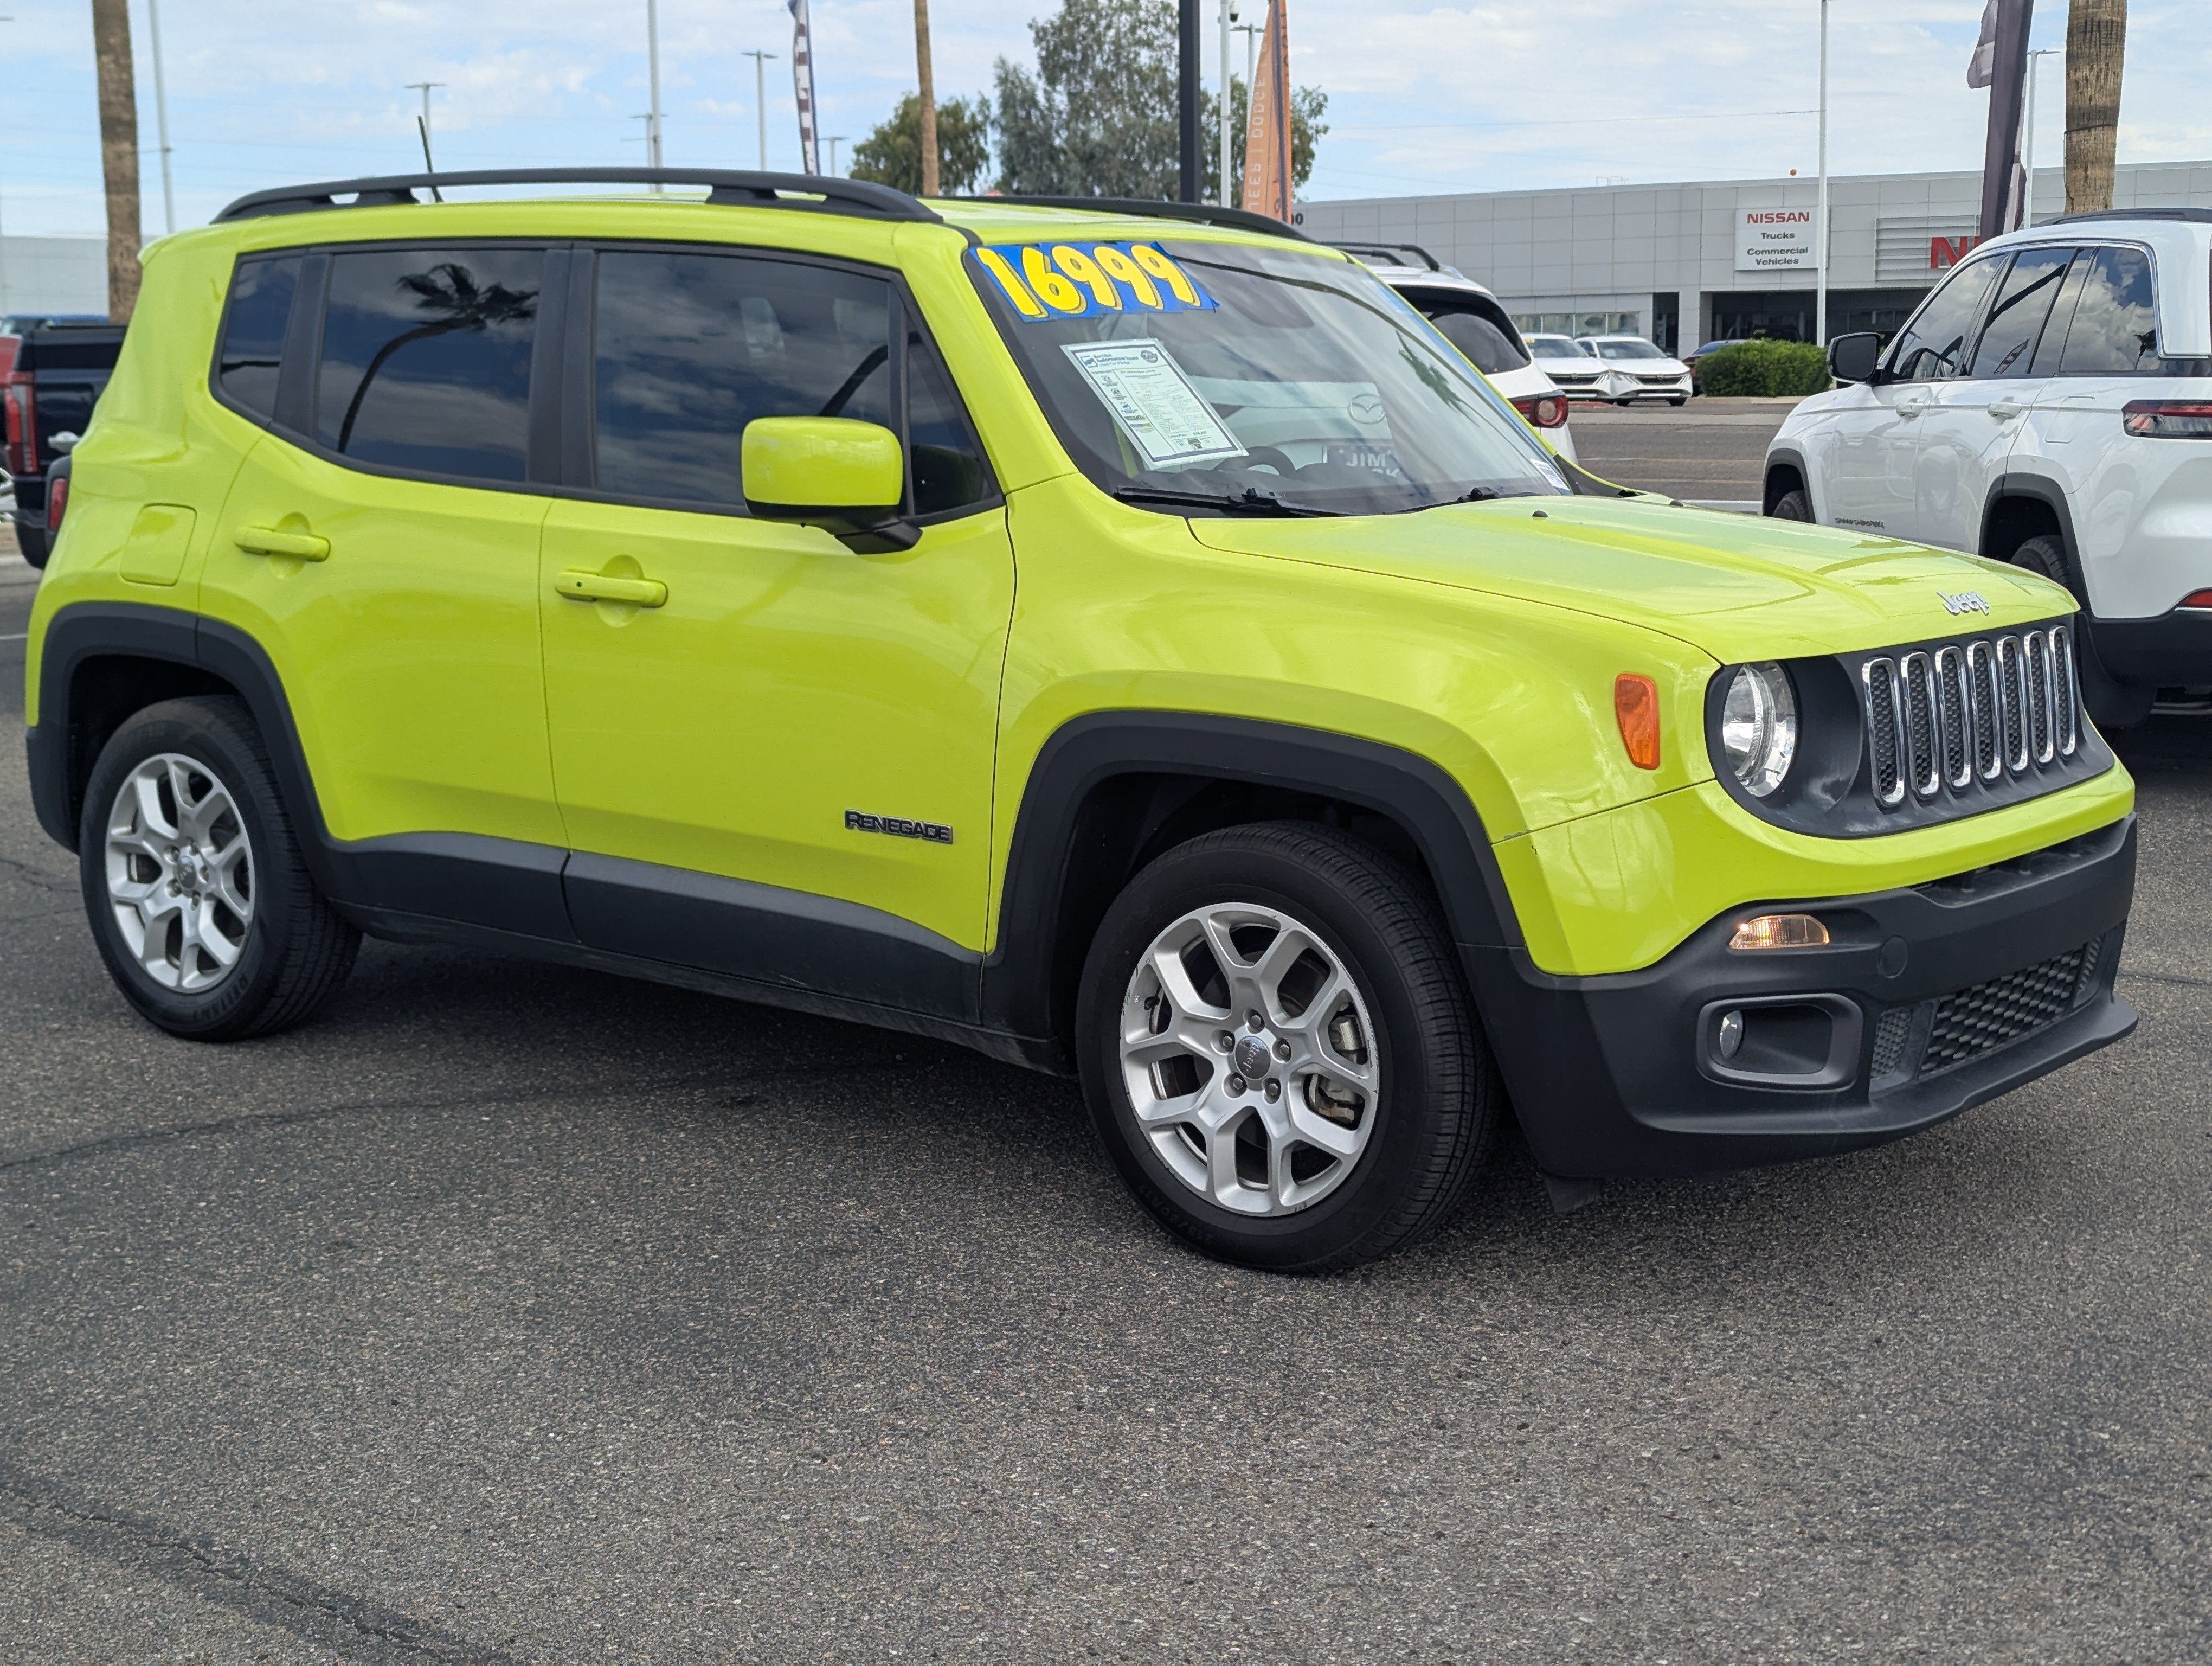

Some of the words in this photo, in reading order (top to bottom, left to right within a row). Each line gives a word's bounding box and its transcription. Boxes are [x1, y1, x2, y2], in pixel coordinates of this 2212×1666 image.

[1747, 212, 1810, 224] NISSAN
[1747, 247, 1808, 255] Commercial
[976, 245, 1201, 318] 16999
[1346, 453, 1386, 467] JIM
[1936, 591, 1989, 616] Jeep
[844, 809, 953, 844] RENEGADE
